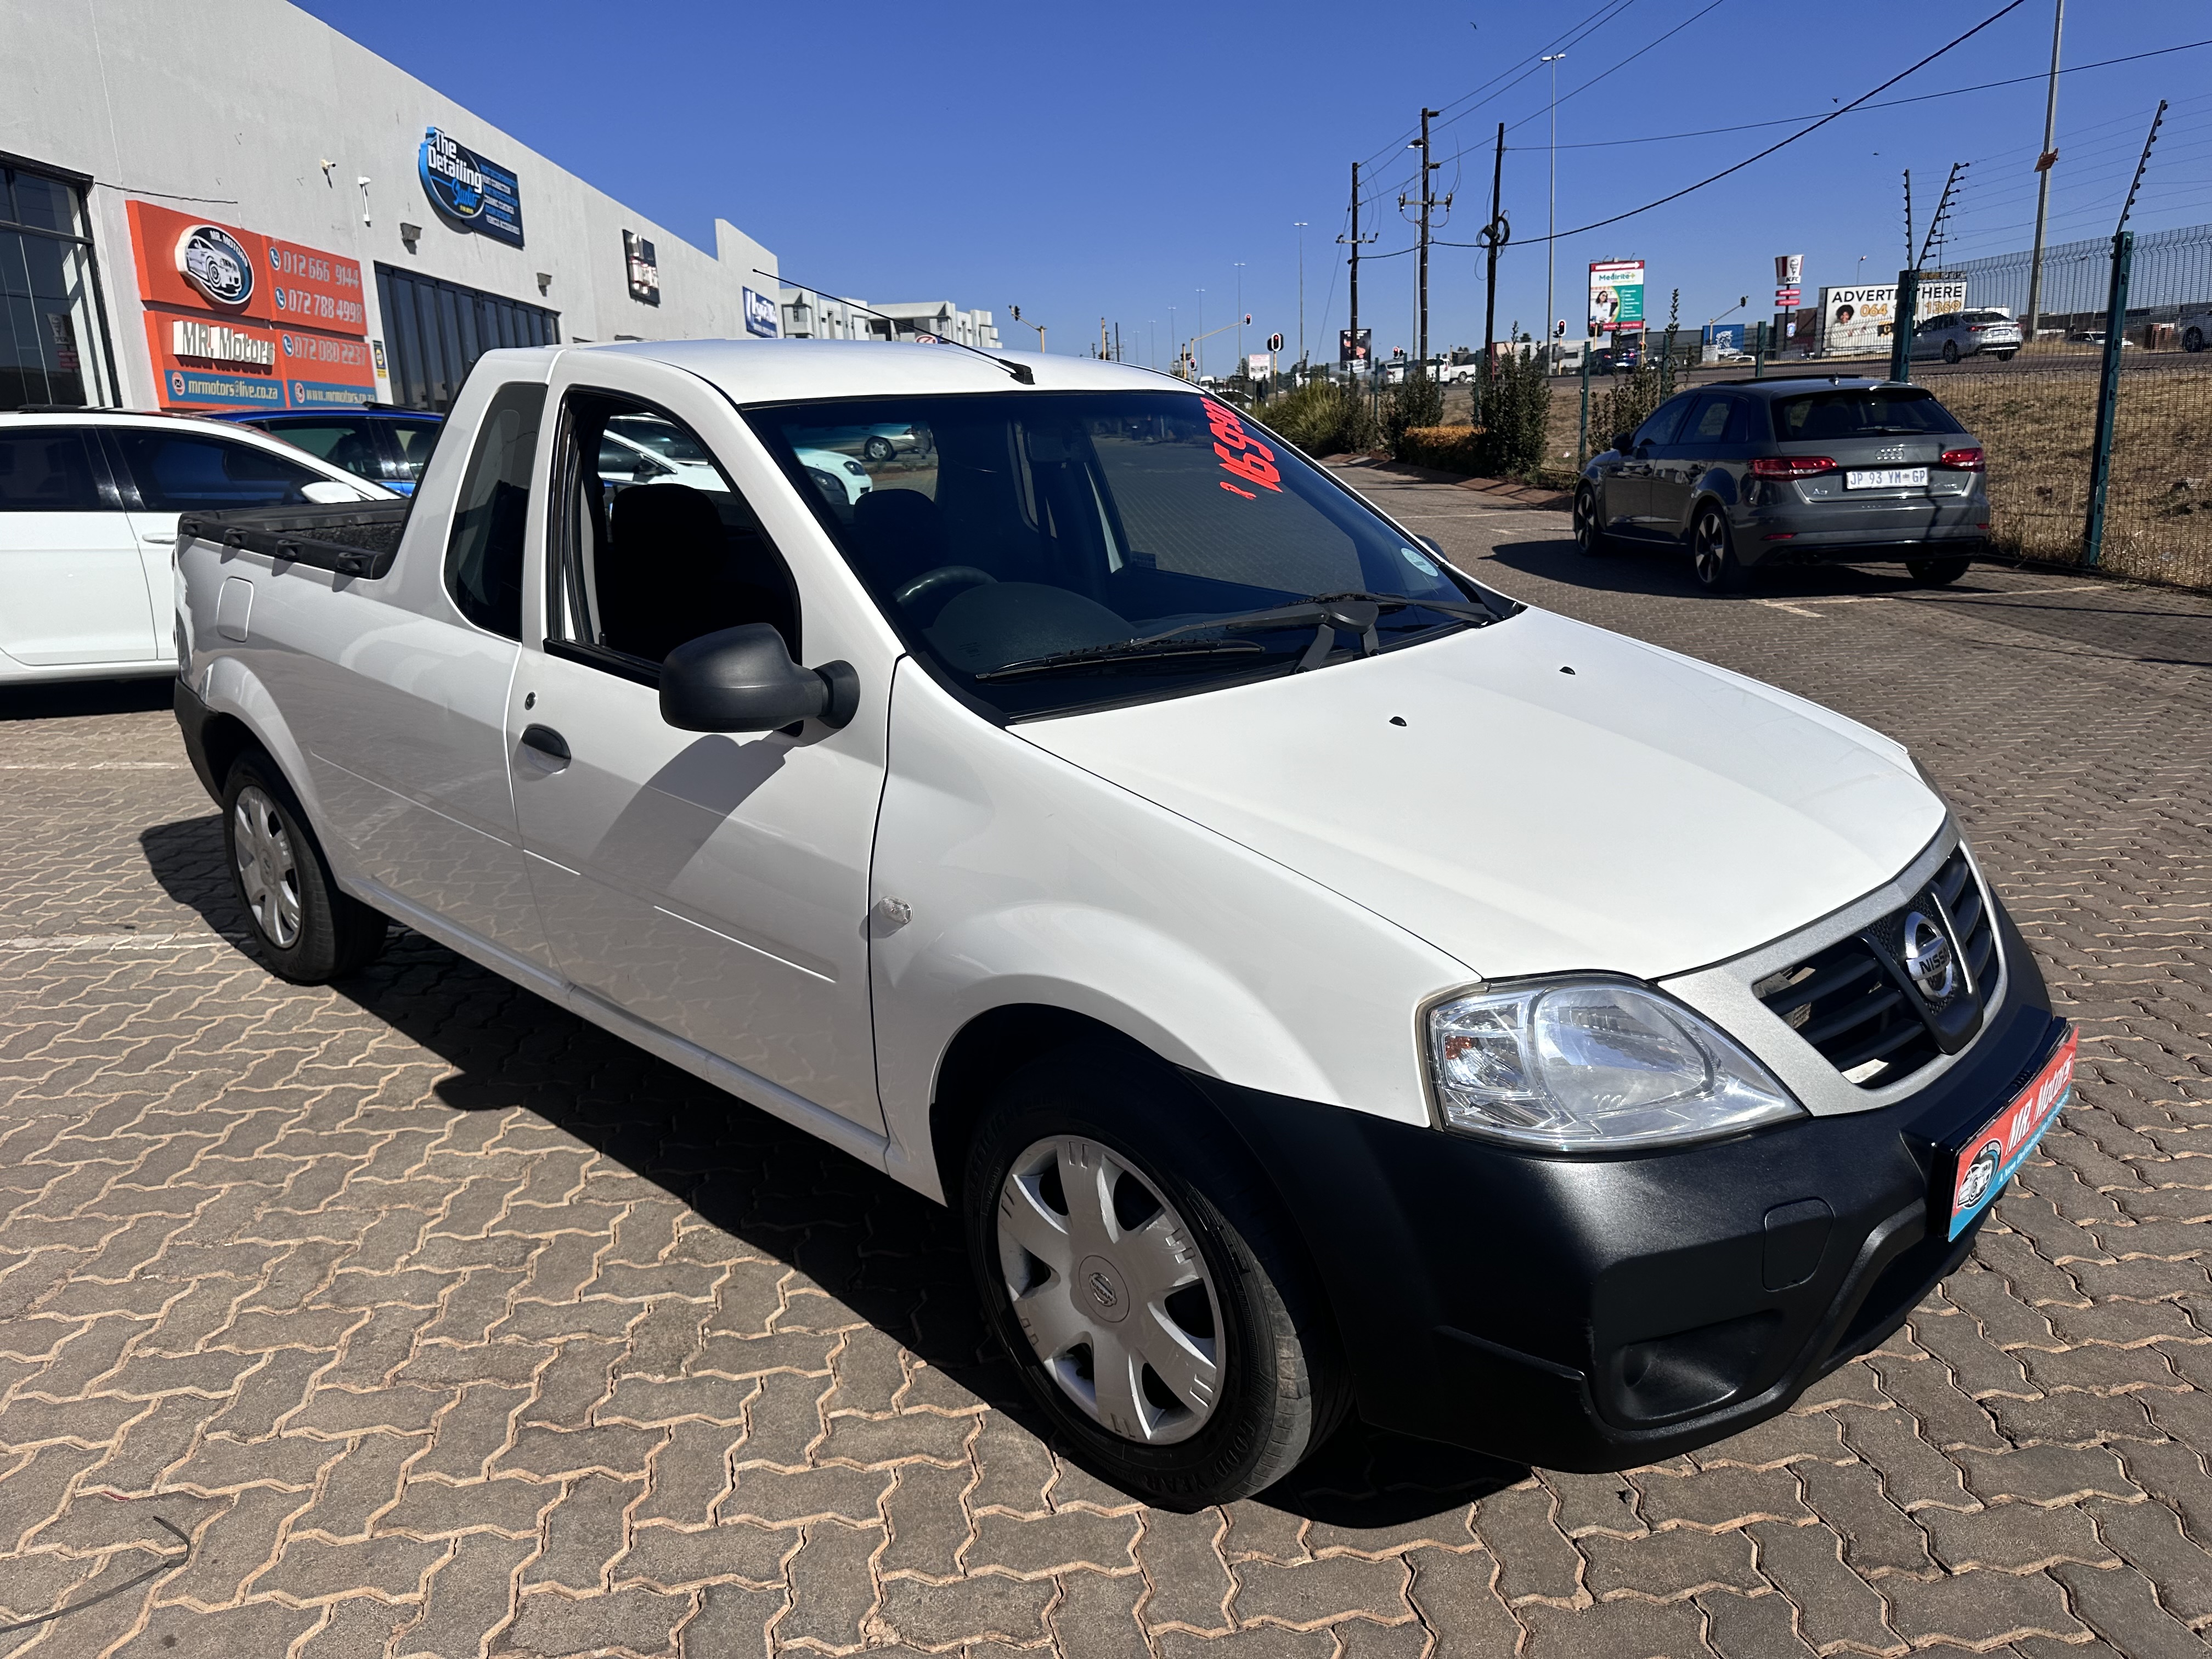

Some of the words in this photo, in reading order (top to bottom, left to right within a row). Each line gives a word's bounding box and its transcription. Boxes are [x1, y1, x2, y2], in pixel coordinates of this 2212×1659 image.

[434, 128, 457, 160] The
[427, 145, 482, 194] Detailing
[283, 251, 306, 276] 012
[308, 259, 330, 283] 666
[335, 266, 359, 289] 9144
[1599, 272, 1629, 281] Medirite
[289, 290, 311, 315] 072
[314, 295, 334, 319] 788
[336, 299, 363, 324] 4998
[1832, 288, 1920, 302] ADVERTI
[1922, 286, 1962, 299] HERE
[1860, 303, 1889, 318] 064
[180, 321, 214, 358] MR.
[219, 326, 275, 366] Motors
[294, 336, 317, 360] 072
[341, 343, 366, 365] 2237
[306, 389, 375, 404] www.mrmotors.coza
[1850, 472, 1863, 486] JP
[1869, 472, 1882, 485] 93
[1888, 471, 1901, 484] YM
[1912, 470, 1926, 483] GP
[1919, 947, 1949, 974] NISSA
[2005, 1098, 2034, 1157] MR.
[2032, 1053, 2073, 1126] Motors
[1091, 1279, 1113, 1302] NISSAN
